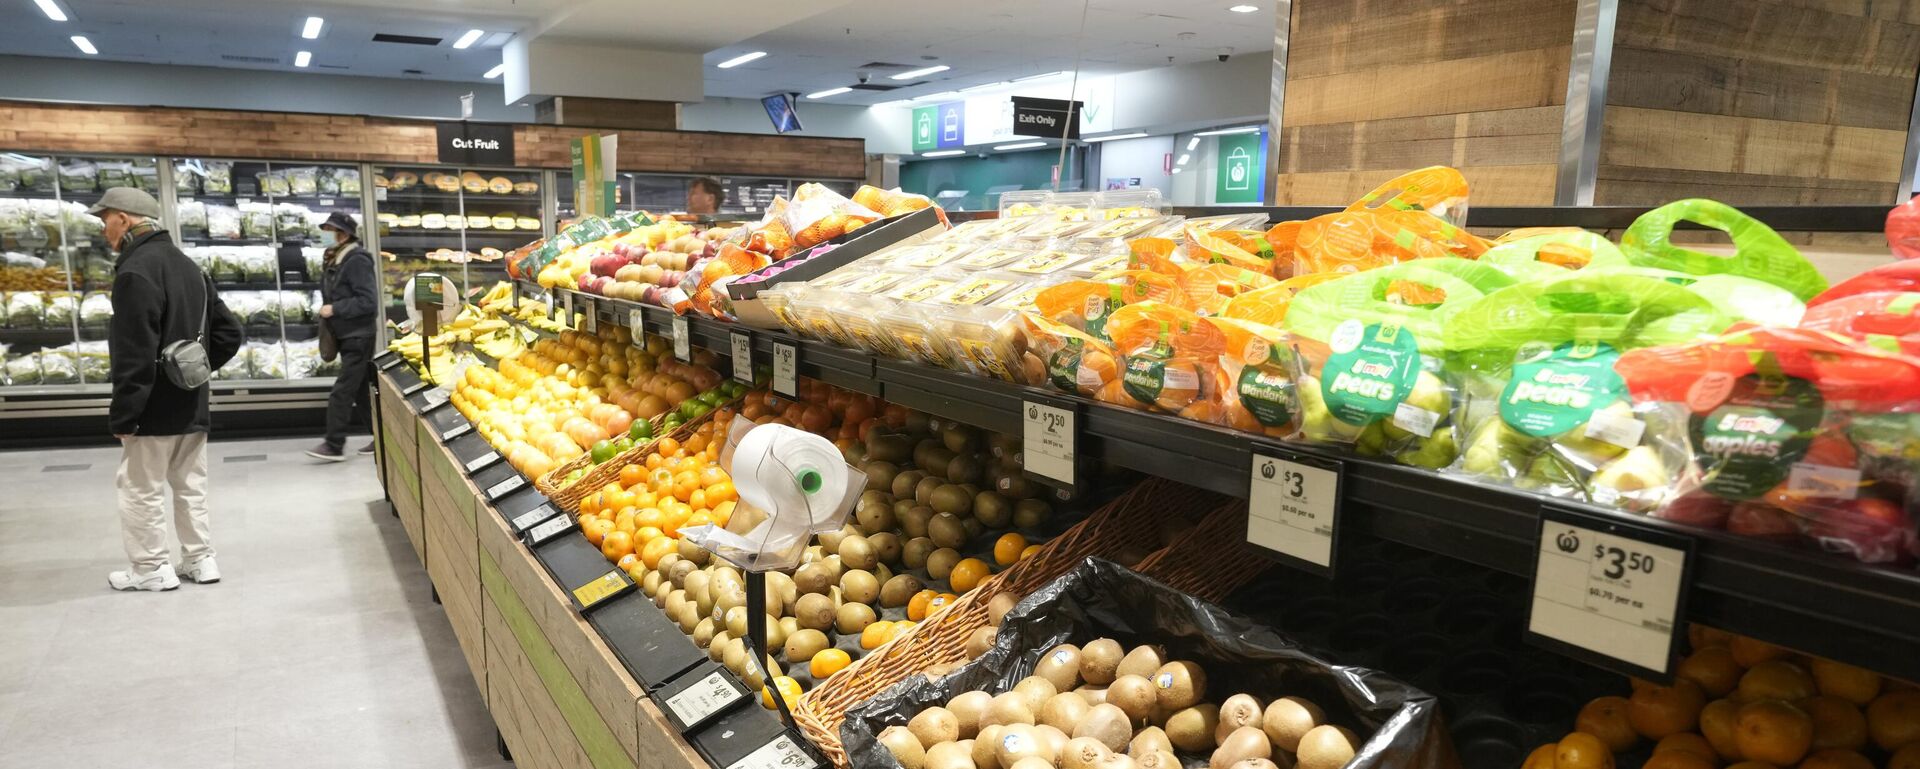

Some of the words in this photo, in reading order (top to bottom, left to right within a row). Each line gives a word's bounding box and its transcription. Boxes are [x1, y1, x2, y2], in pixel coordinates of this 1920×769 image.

[1018, 113, 1036, 124] Exit
[1036, 115, 1056, 127] Only
[452, 138, 473, 149] Cut
[474, 138, 499, 150] Fruit
[1329, 371, 1395, 400] pears
[1508, 381, 1593, 408] pears
[1702, 434, 1783, 459] apples
[1284, 470, 1304, 498] $3
[1614, 595, 1631, 605] per
